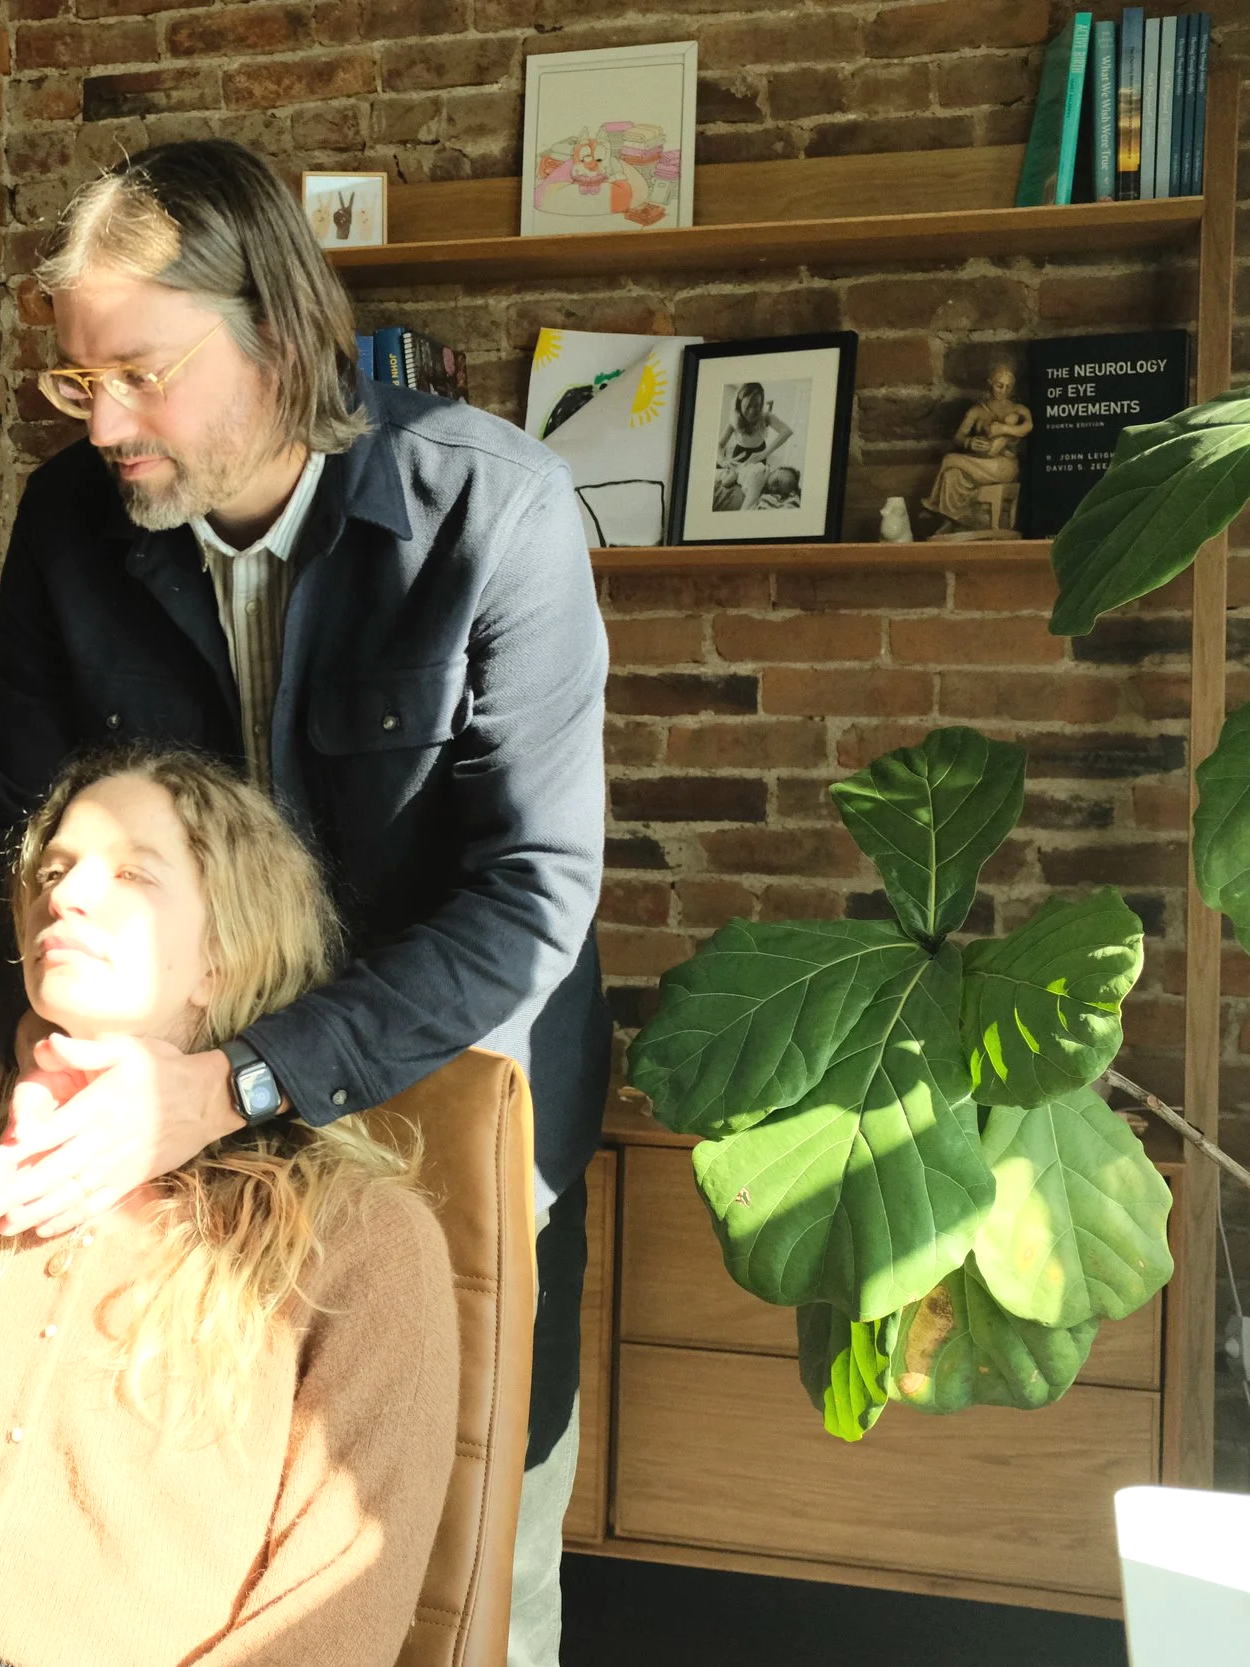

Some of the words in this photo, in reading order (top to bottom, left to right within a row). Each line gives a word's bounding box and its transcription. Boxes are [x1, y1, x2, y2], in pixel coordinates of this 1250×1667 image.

[1075, 24, 1088, 48] ACTIVE
[1072, 51, 1086, 73] BIRTH
[1101, 55, 1111, 81] What
[1101, 82, 1111, 97] We
[1101, 99, 1111, 122] Wish
[1101, 124, 1111, 147] Were
[1101, 148, 1111, 170] True
[389, 353, 398, 378] JOHN
[1046, 368, 1070, 379] THE
[1074, 359, 1167, 377] NEUROLOGY
[1047, 387, 1063, 398] OF
[1067, 383, 1096, 397] EYE
[1046, 400, 1140, 418] MOVEMENTS
[1046, 464, 1074, 472] DAVID
[1059, 453, 1084, 461] JOHN
